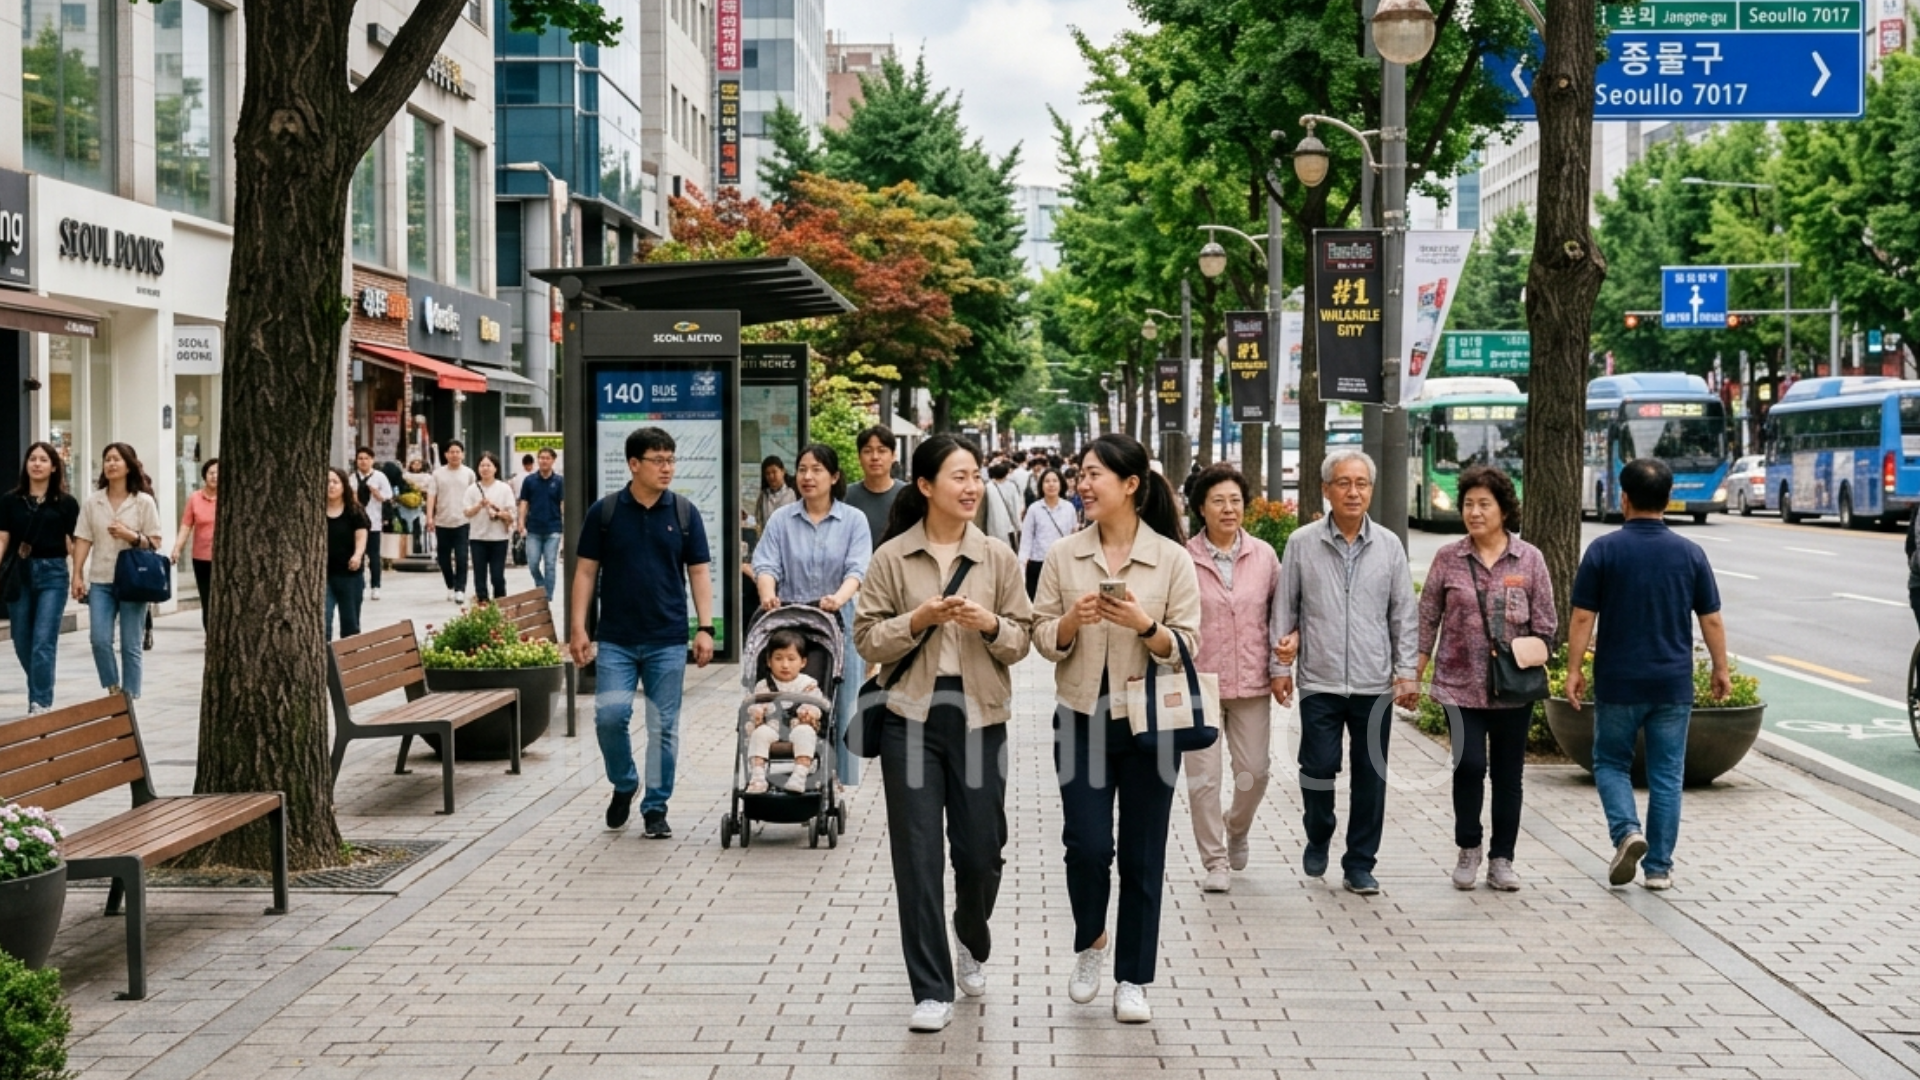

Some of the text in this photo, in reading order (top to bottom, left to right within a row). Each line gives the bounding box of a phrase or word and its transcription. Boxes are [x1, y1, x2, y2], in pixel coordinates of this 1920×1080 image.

[1749, 7, 1850, 23] Seoullo 7017
[1619, 42, 1724, 75] 종물구
[1595, 83, 1748, 105] Seoullo 7017
[1331, 277, 1370, 305] #1
[603, 382, 644, 403] 140
